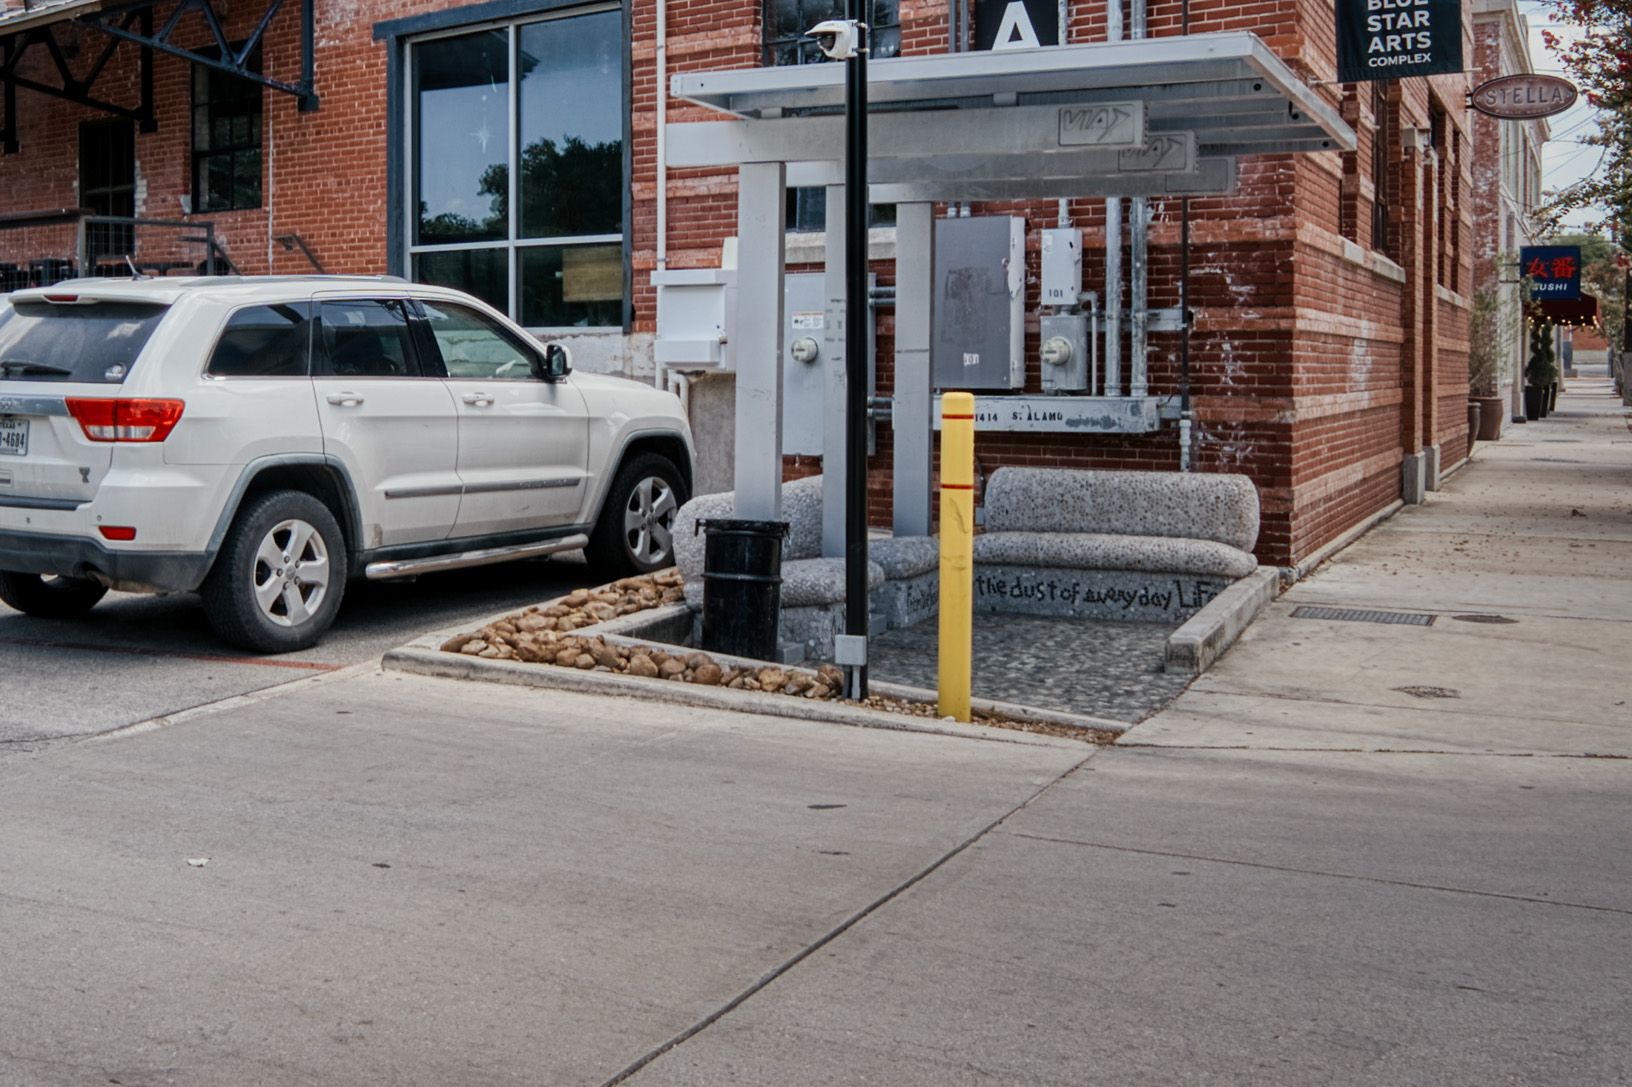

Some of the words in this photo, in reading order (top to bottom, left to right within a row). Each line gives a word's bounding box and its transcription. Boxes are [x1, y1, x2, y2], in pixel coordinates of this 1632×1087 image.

[992, 0, 1041, 50] A
[1368, 11, 1430, 32] STAR
[1368, 31, 1432, 53] ARTS
[1368, 52, 1432, 68] COMPLEX
[1486, 85, 1565, 108] STELLA
[1048, 288, 1064, 298] 101
[1027, 411, 1064, 421] ALAMO
[975, 575, 1008, 598] the
[1010, 576, 1058, 602] dust
[1060, 582, 1080, 604] of
